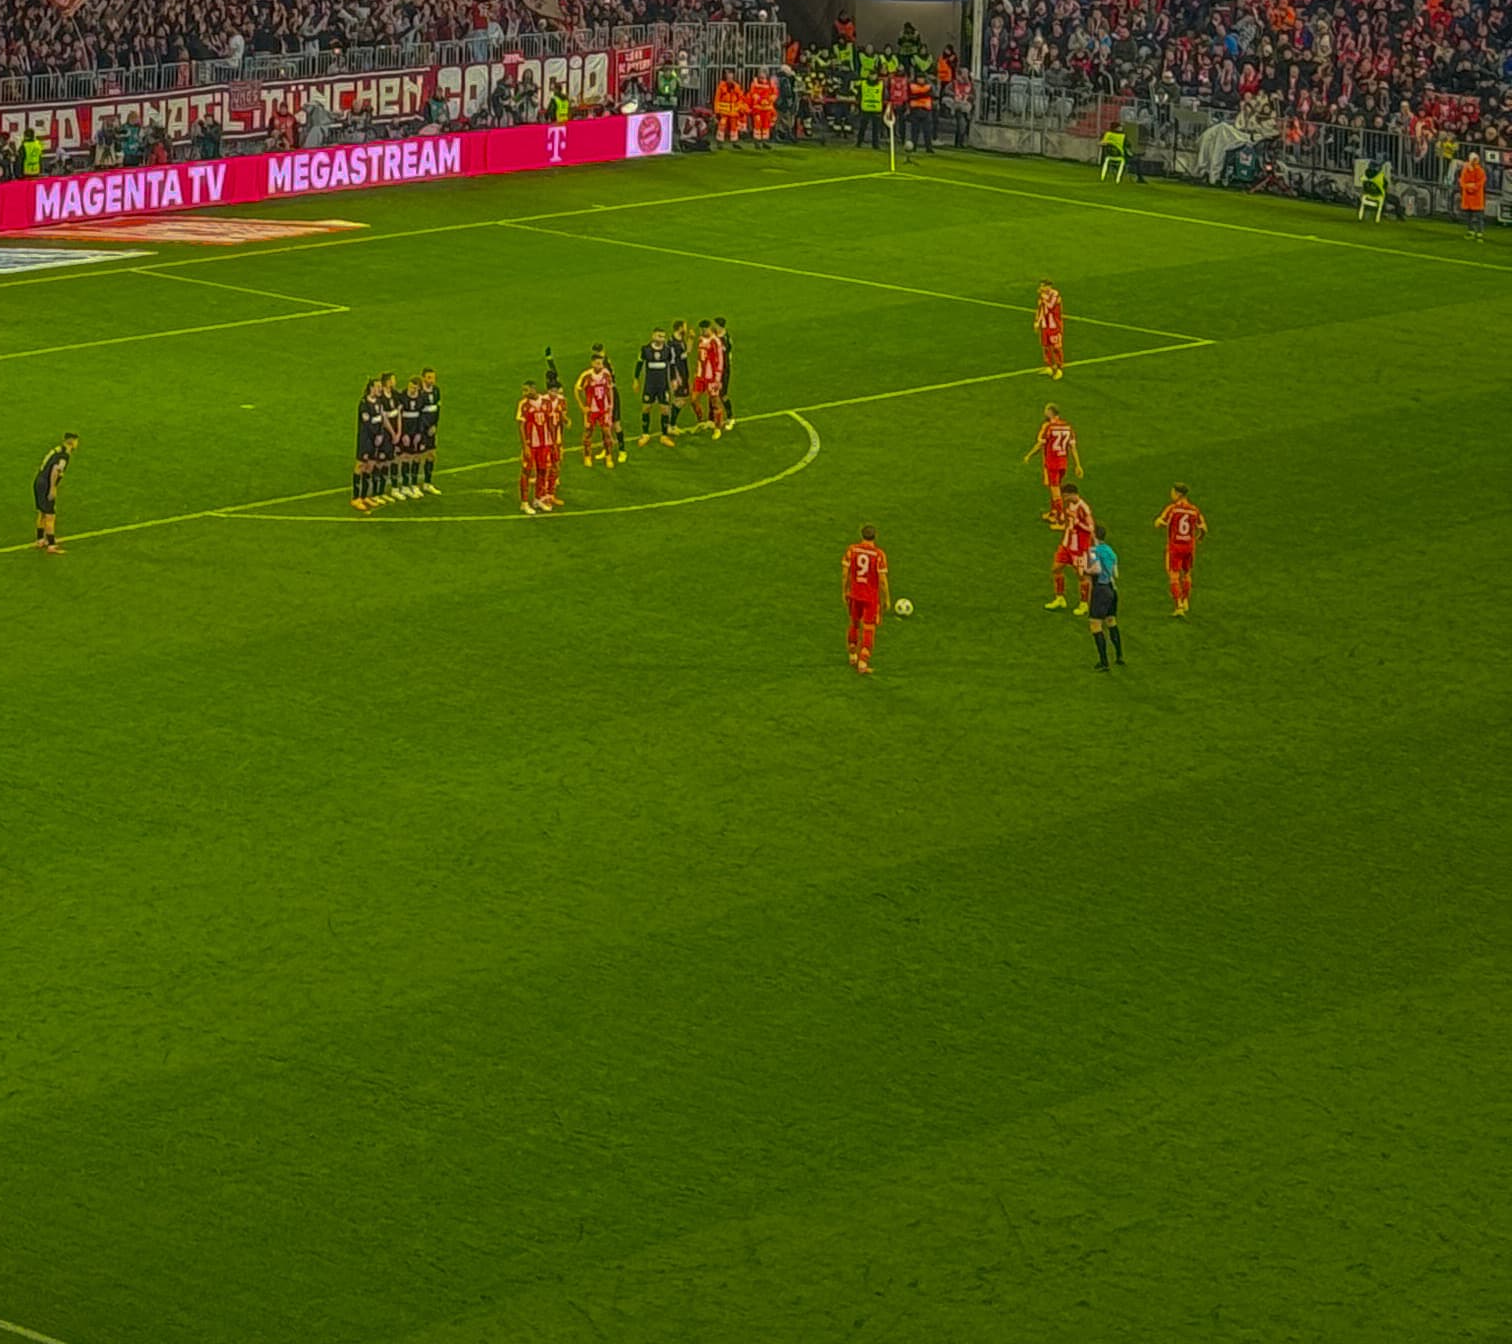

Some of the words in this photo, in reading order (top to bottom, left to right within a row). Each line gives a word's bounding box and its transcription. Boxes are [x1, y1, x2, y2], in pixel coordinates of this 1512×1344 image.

[267, 137, 462, 195] MEGASTREAM
[34, 170, 184, 222] MAGENTA
[190, 163, 227, 202] TV
[1051, 430, 1071, 451] 27
[1178, 513, 1190, 535] 6
[856, 554, 869, 576] 9
